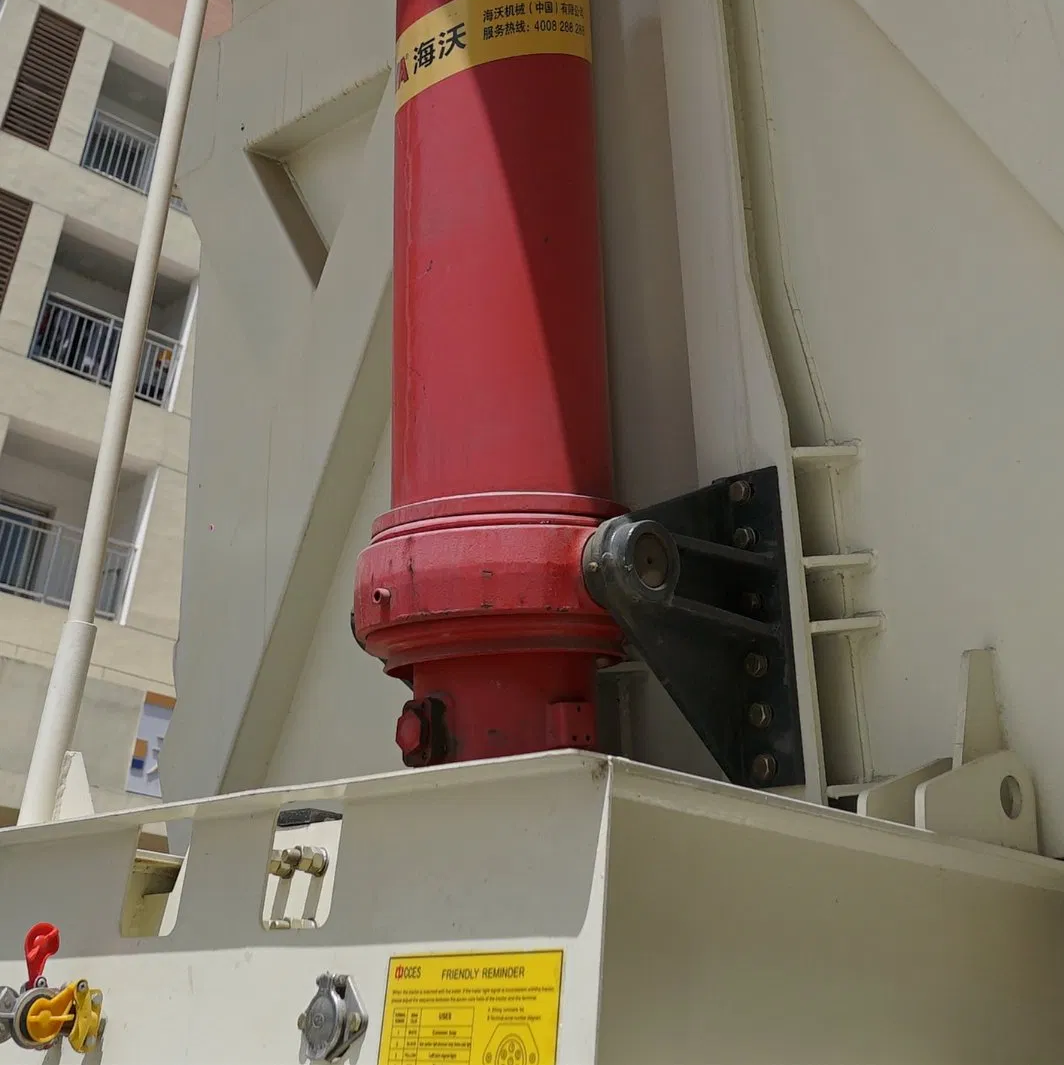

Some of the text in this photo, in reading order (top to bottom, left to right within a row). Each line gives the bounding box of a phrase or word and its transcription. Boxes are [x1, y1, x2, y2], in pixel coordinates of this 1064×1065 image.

[534, 20, 557, 32] 4008
[413, 22, 467, 75] 海沃
[441, 965, 526, 980] FRIENDLY REMINDER
